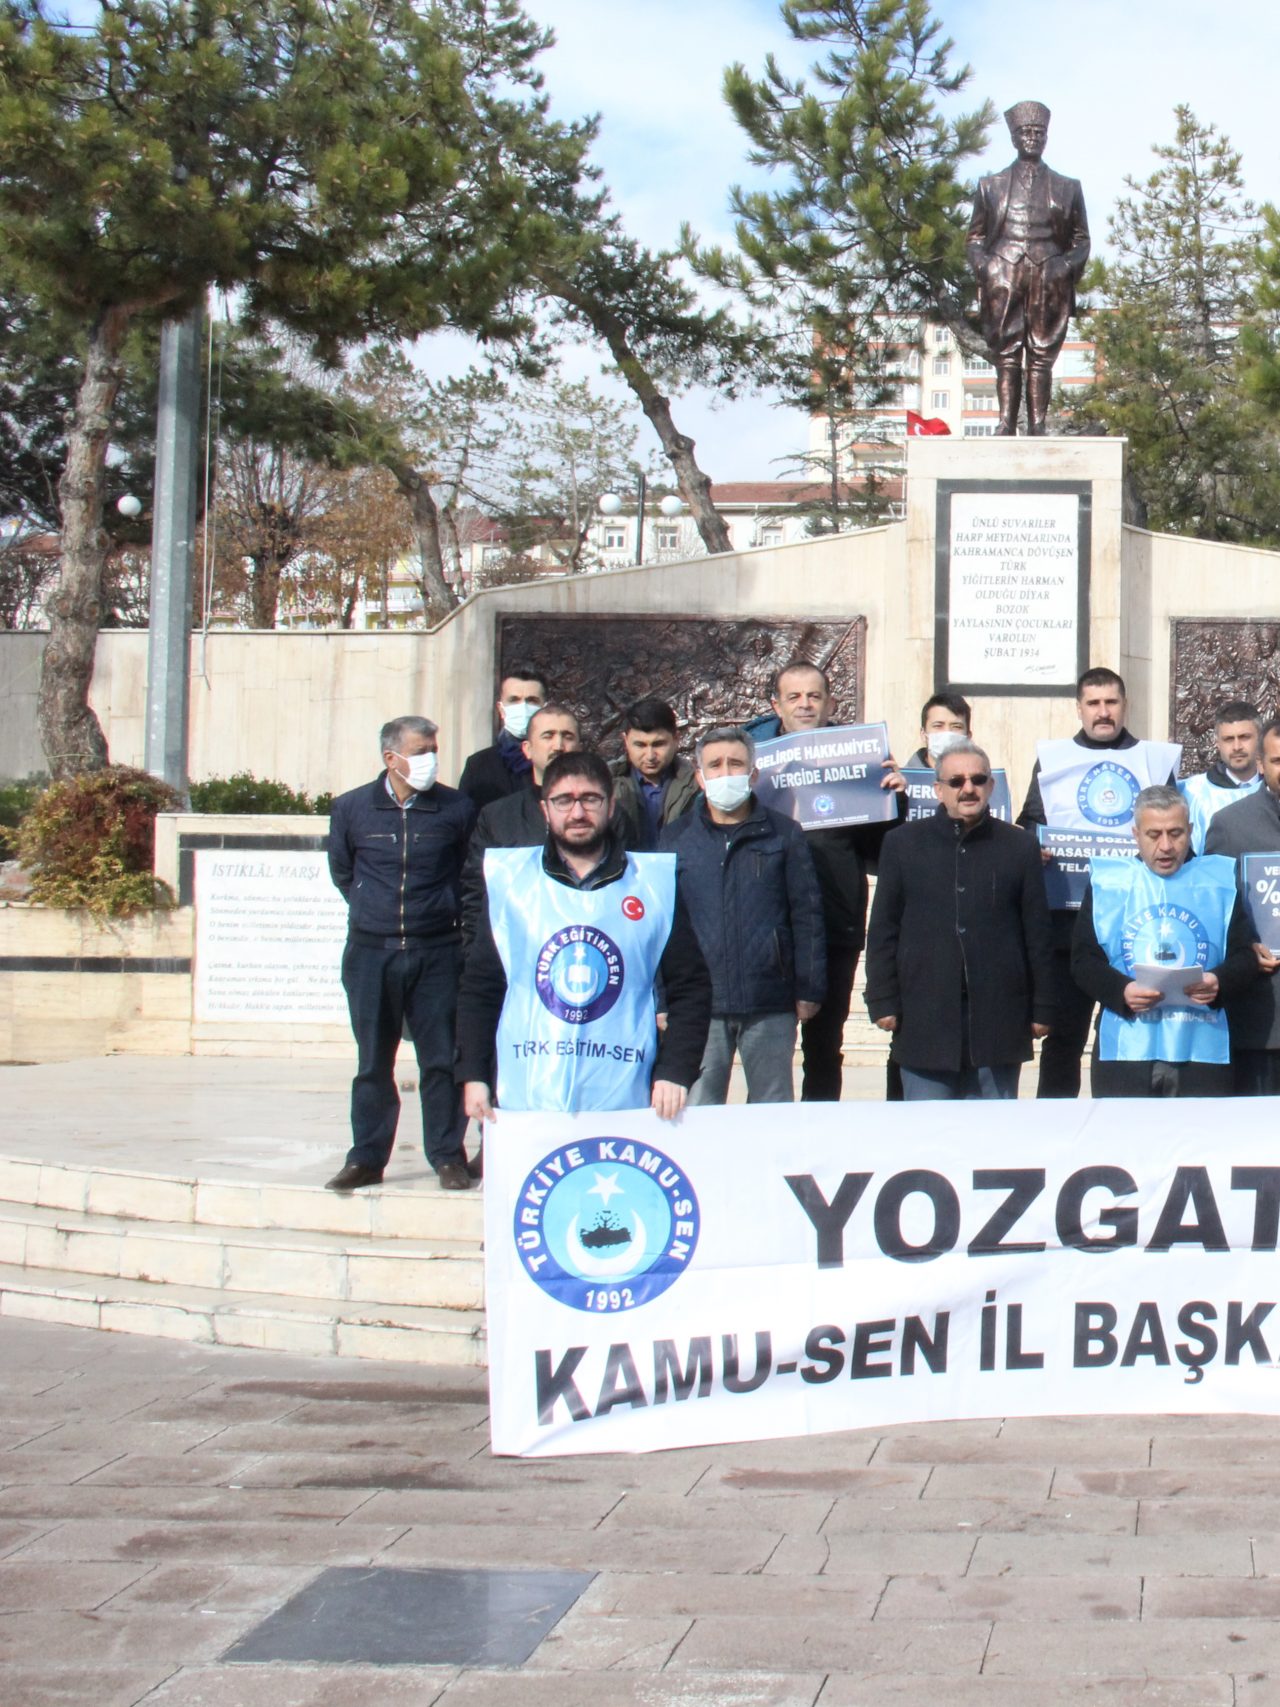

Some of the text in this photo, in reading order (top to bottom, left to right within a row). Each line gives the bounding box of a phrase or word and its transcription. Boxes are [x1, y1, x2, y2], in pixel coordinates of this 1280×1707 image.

[972, 516, 1056, 528] ÜNLÜ SUVARİLER
[956, 533, 1071, 543] HARP MEYDANLARINDA
[953, 546, 1074, 559] KAHRAMANCA DÖVÜŞEN
[1000, 560, 1027, 571] TÜRK
[1021, 576, 1065, 586] HARMAN
[975, 588, 1050, 600] OLDUĞU DİYAR
[996, 604, 1030, 614] BOZOK
[953, 619, 1073, 630] YAYLASININ ÇOCUKLARI
[989, 633, 1036, 643] VAROLUN
[984, 648, 1016, 658] ŞUBAT
[755, 738, 881, 770] GELİRDE HAKKANİYET,
[771, 764, 868, 790] VERGİDE ADALET
[1048, 833, 1093, 843] TOPLU
[537, 928, 620, 985] TÜRK EĞİTİM-SEN
[564, 1009, 588, 1021] 1992
[556, 1038, 645, 1063] EĞİTİM-SEN
[518, 1141, 696, 1275] TÜRKİYE KAMU-SEN
[585, 1288, 635, 1311] 1992
[534, 1310, 951, 1426] KAMU-SEN
[979, 1290, 1044, 1371] İL
